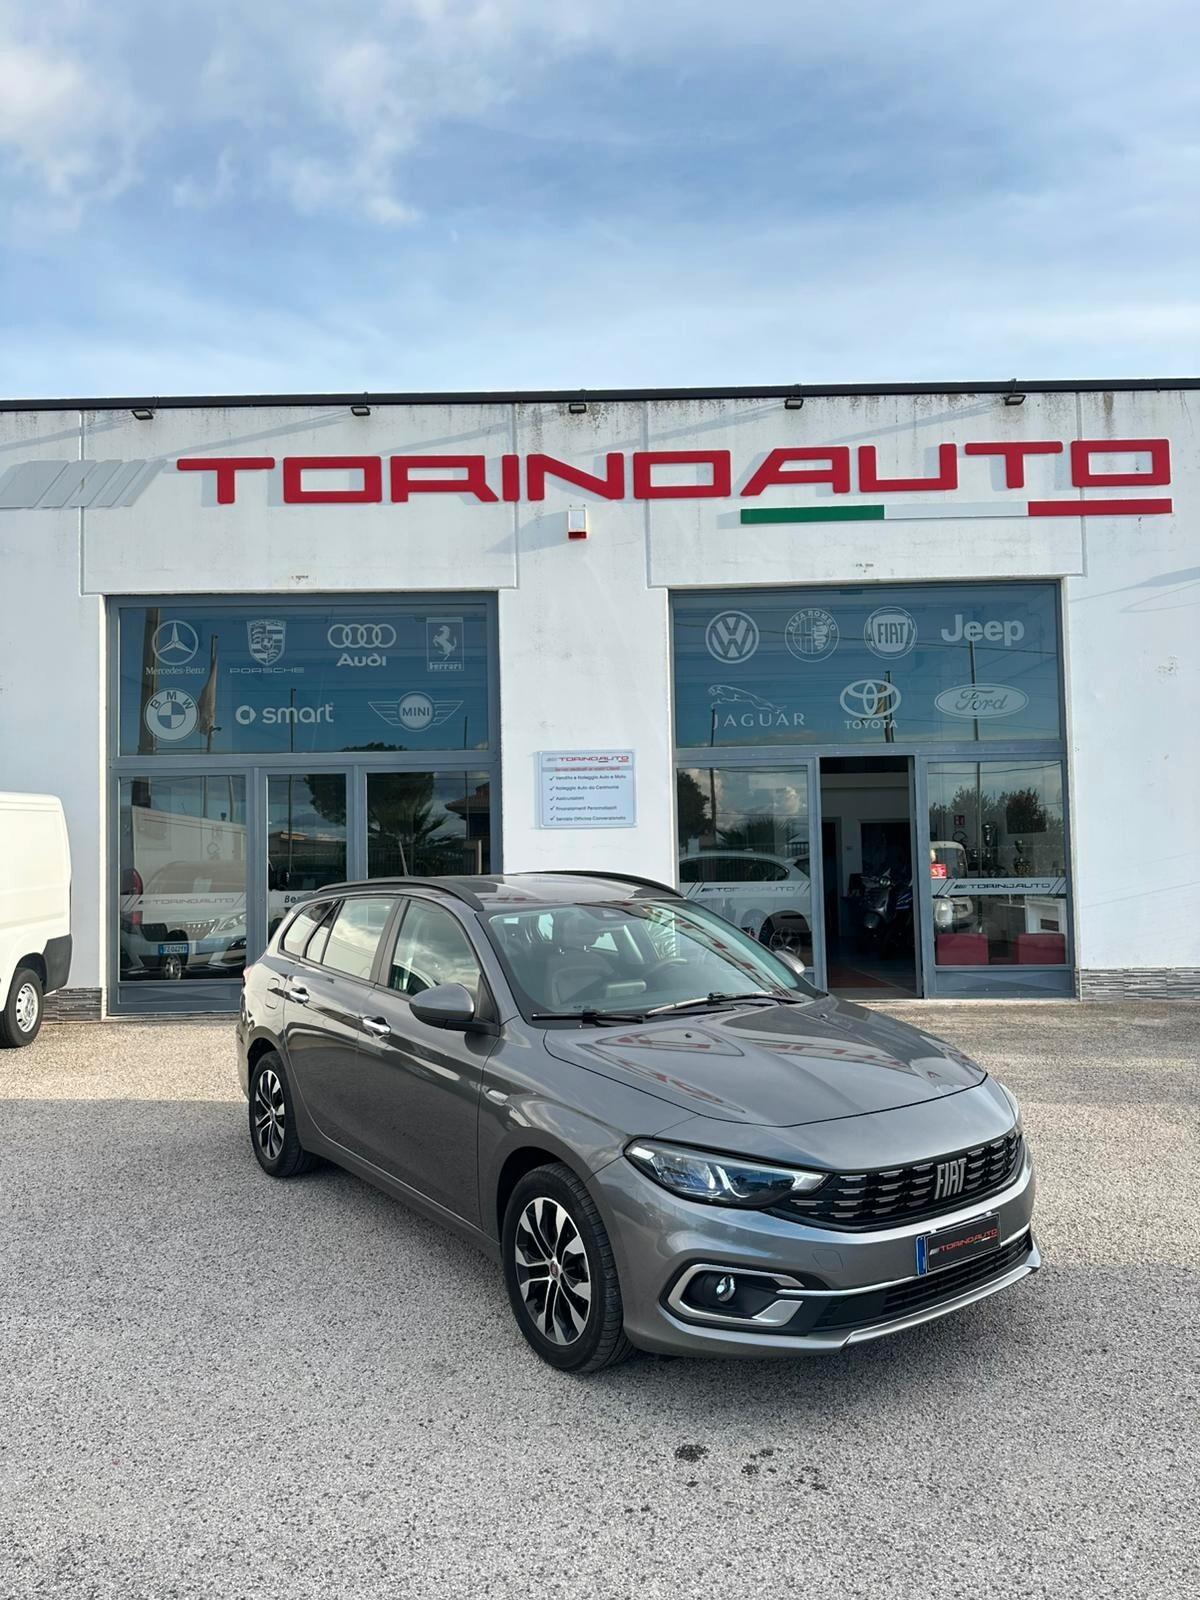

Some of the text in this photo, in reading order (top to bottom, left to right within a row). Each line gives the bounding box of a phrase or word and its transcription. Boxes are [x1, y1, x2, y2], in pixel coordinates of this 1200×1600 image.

[177, 439, 1170, 503] TORINOAUTO
[877, 621, 906, 644] FIAT
[941, 614, 1025, 646] Jeep
[229, 666, 305, 674] PORSCHE
[336, 653, 387, 667] Audi
[145, 666, 206, 676] Mercedes-Benz
[150, 691, 194, 710] BMW
[955, 689, 1009, 711] Ford
[261, 703, 335, 724] smart
[402, 706, 430, 717] MINI
[713, 712, 805, 730] JAGUAR
[844, 719, 898, 730] TOYOTA
[934, 1157, 967, 1200] FIAT
[940, 1228, 998, 1253] TORINOAUTO
